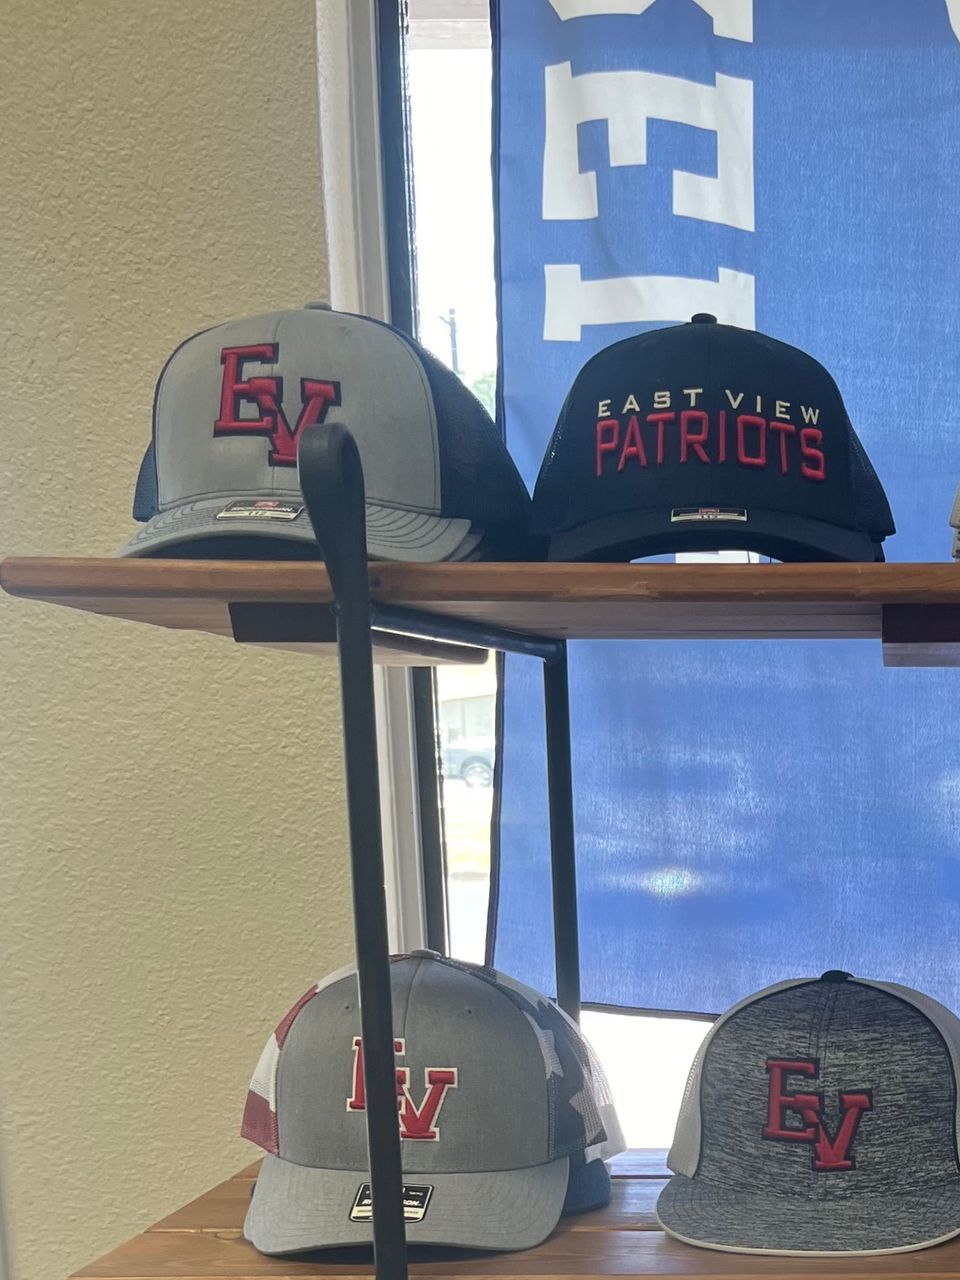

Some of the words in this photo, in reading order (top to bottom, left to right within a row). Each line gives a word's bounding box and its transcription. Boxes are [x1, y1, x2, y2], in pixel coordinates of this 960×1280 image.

[213, 342, 342, 468] EV
[595, 410, 826, 481] PATRIOTS
[597, 388, 703, 418] EAST
[725, 389, 821, 425] VIEW
[762, 1057, 873, 1172] EV
